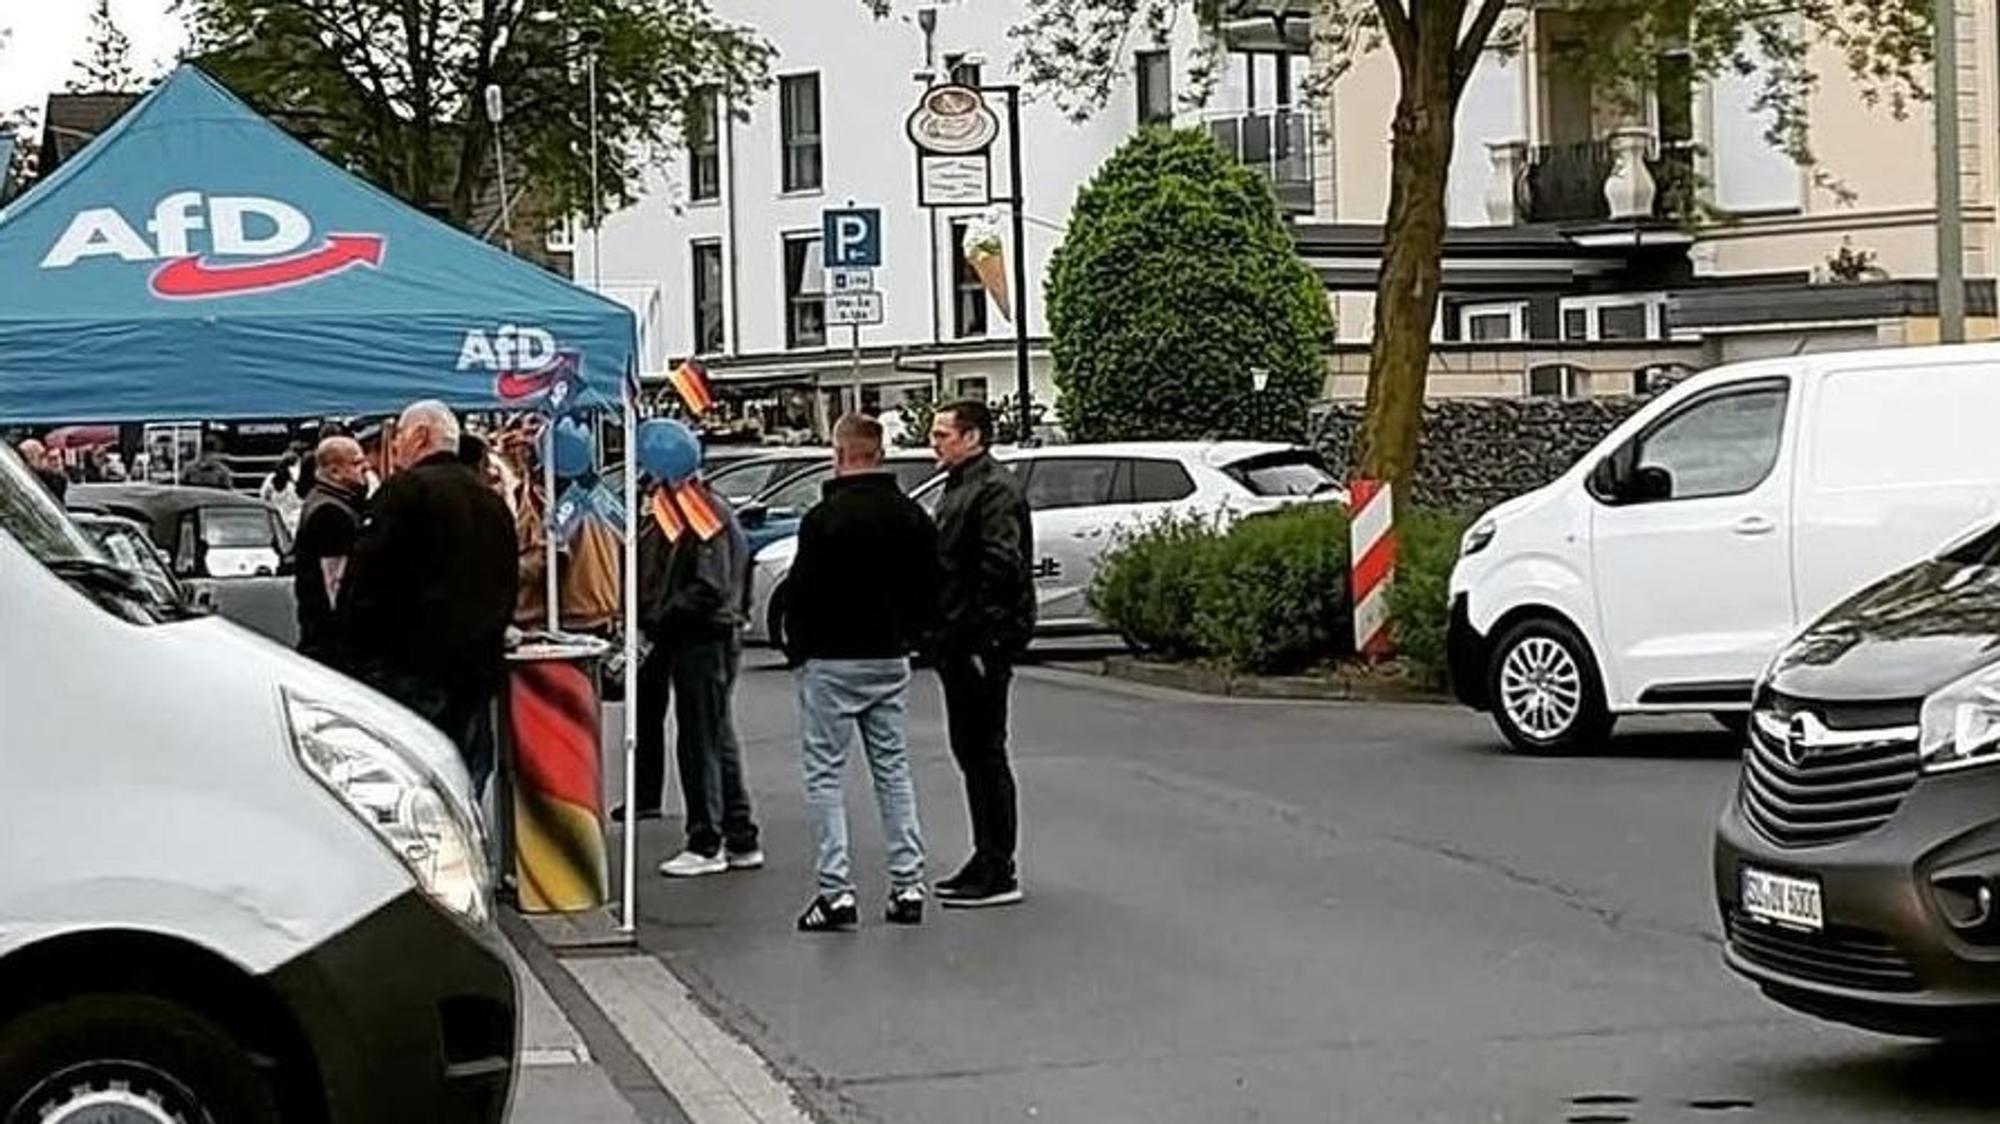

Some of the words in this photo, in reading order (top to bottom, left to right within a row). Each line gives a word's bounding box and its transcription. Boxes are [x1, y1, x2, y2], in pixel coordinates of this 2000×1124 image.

[39, 191, 312, 268] AfD
[836, 215, 867, 261] P
[456, 324, 555, 370] AfD
